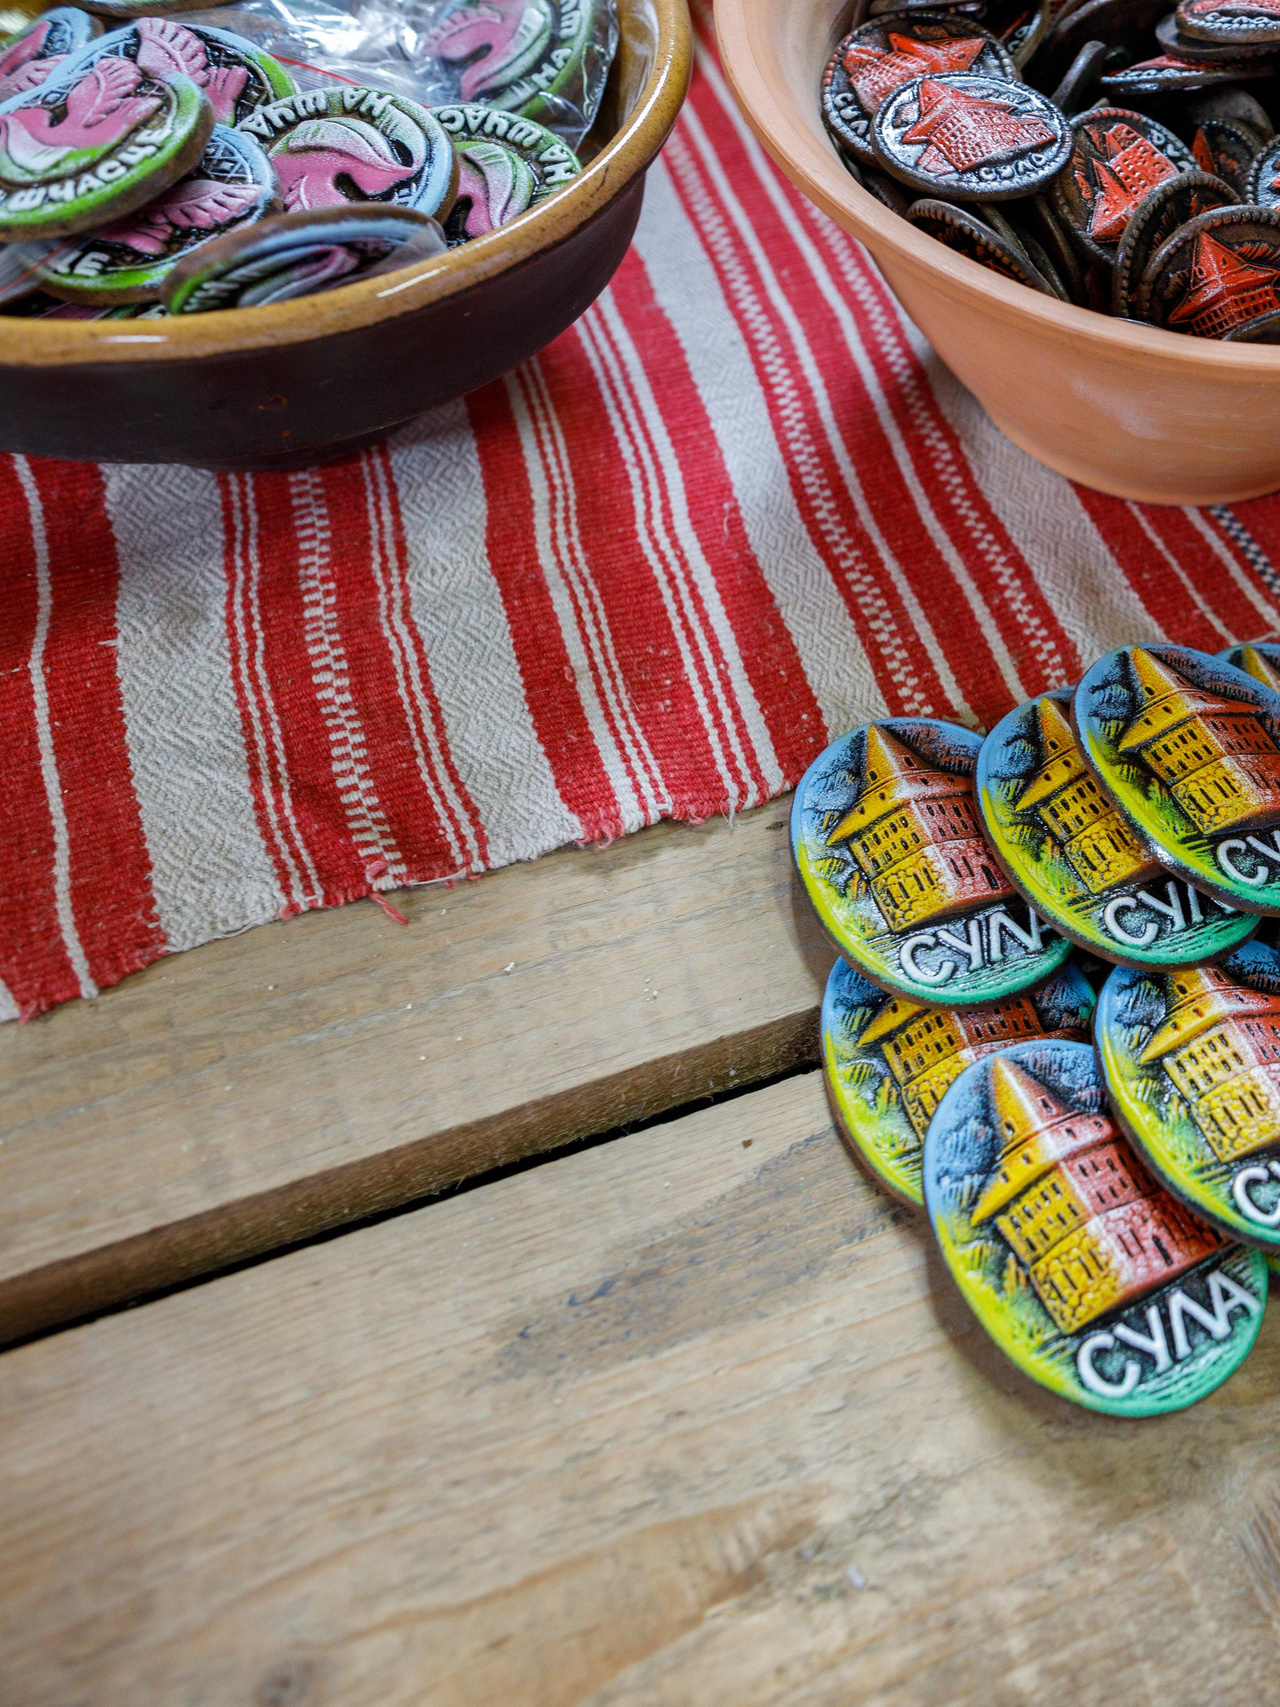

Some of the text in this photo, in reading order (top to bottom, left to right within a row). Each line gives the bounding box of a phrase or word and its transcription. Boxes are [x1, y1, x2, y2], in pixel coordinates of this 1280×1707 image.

[343, 87, 395, 118] НА
[539, 144, 577, 185] НА
[1076, 1269, 1263, 1398] СУЛА
